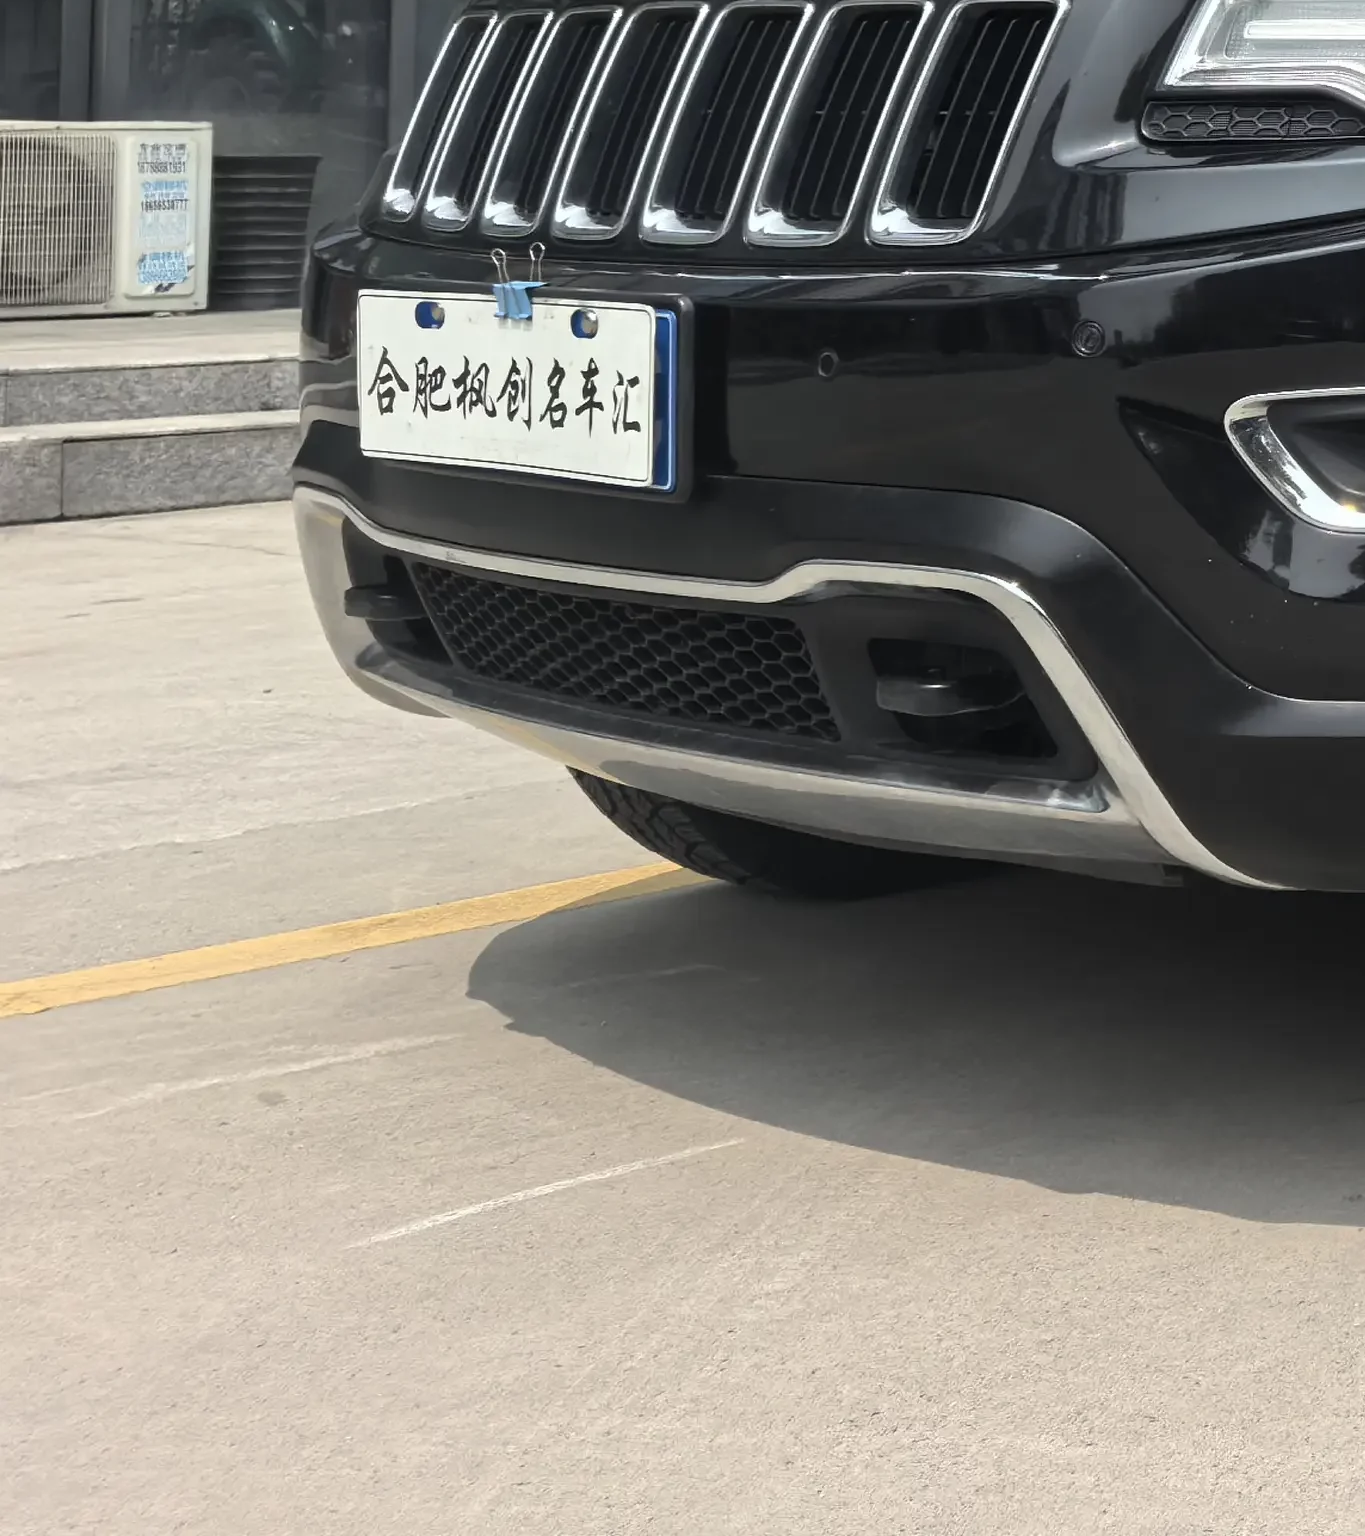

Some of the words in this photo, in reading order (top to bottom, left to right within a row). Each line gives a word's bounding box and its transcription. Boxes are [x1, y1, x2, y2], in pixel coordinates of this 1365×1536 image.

[368, 346, 642, 438] 合肥枫创名车汇
